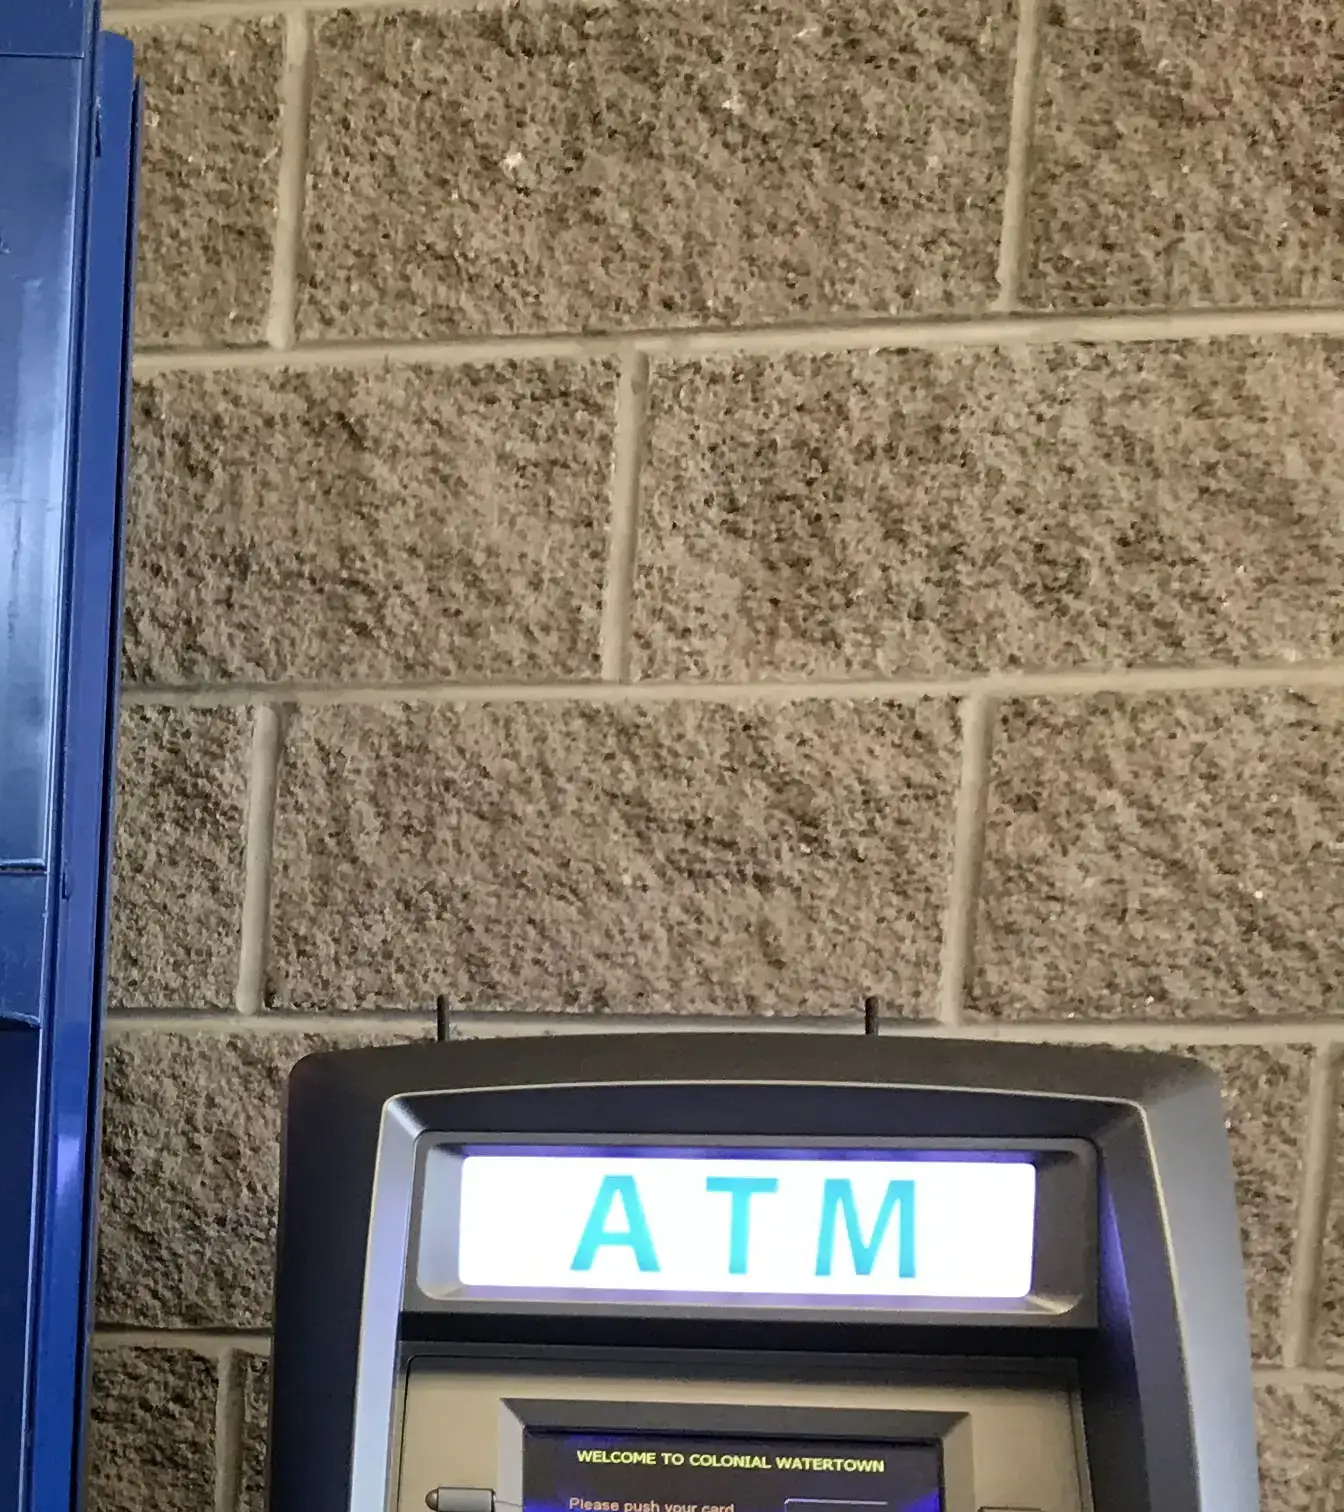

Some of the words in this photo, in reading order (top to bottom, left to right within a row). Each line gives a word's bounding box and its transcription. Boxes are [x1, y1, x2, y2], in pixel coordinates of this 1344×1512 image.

[570, 1174, 917, 1278] ATM
[577, 1450, 656, 1465] WELCOME
[661, 1452, 684, 1466] TO
[689, 1454, 771, 1469] COLONIAL
[775, 1456, 884, 1472] WATERTOWN
[569, 1497, 619, 1512] Please
